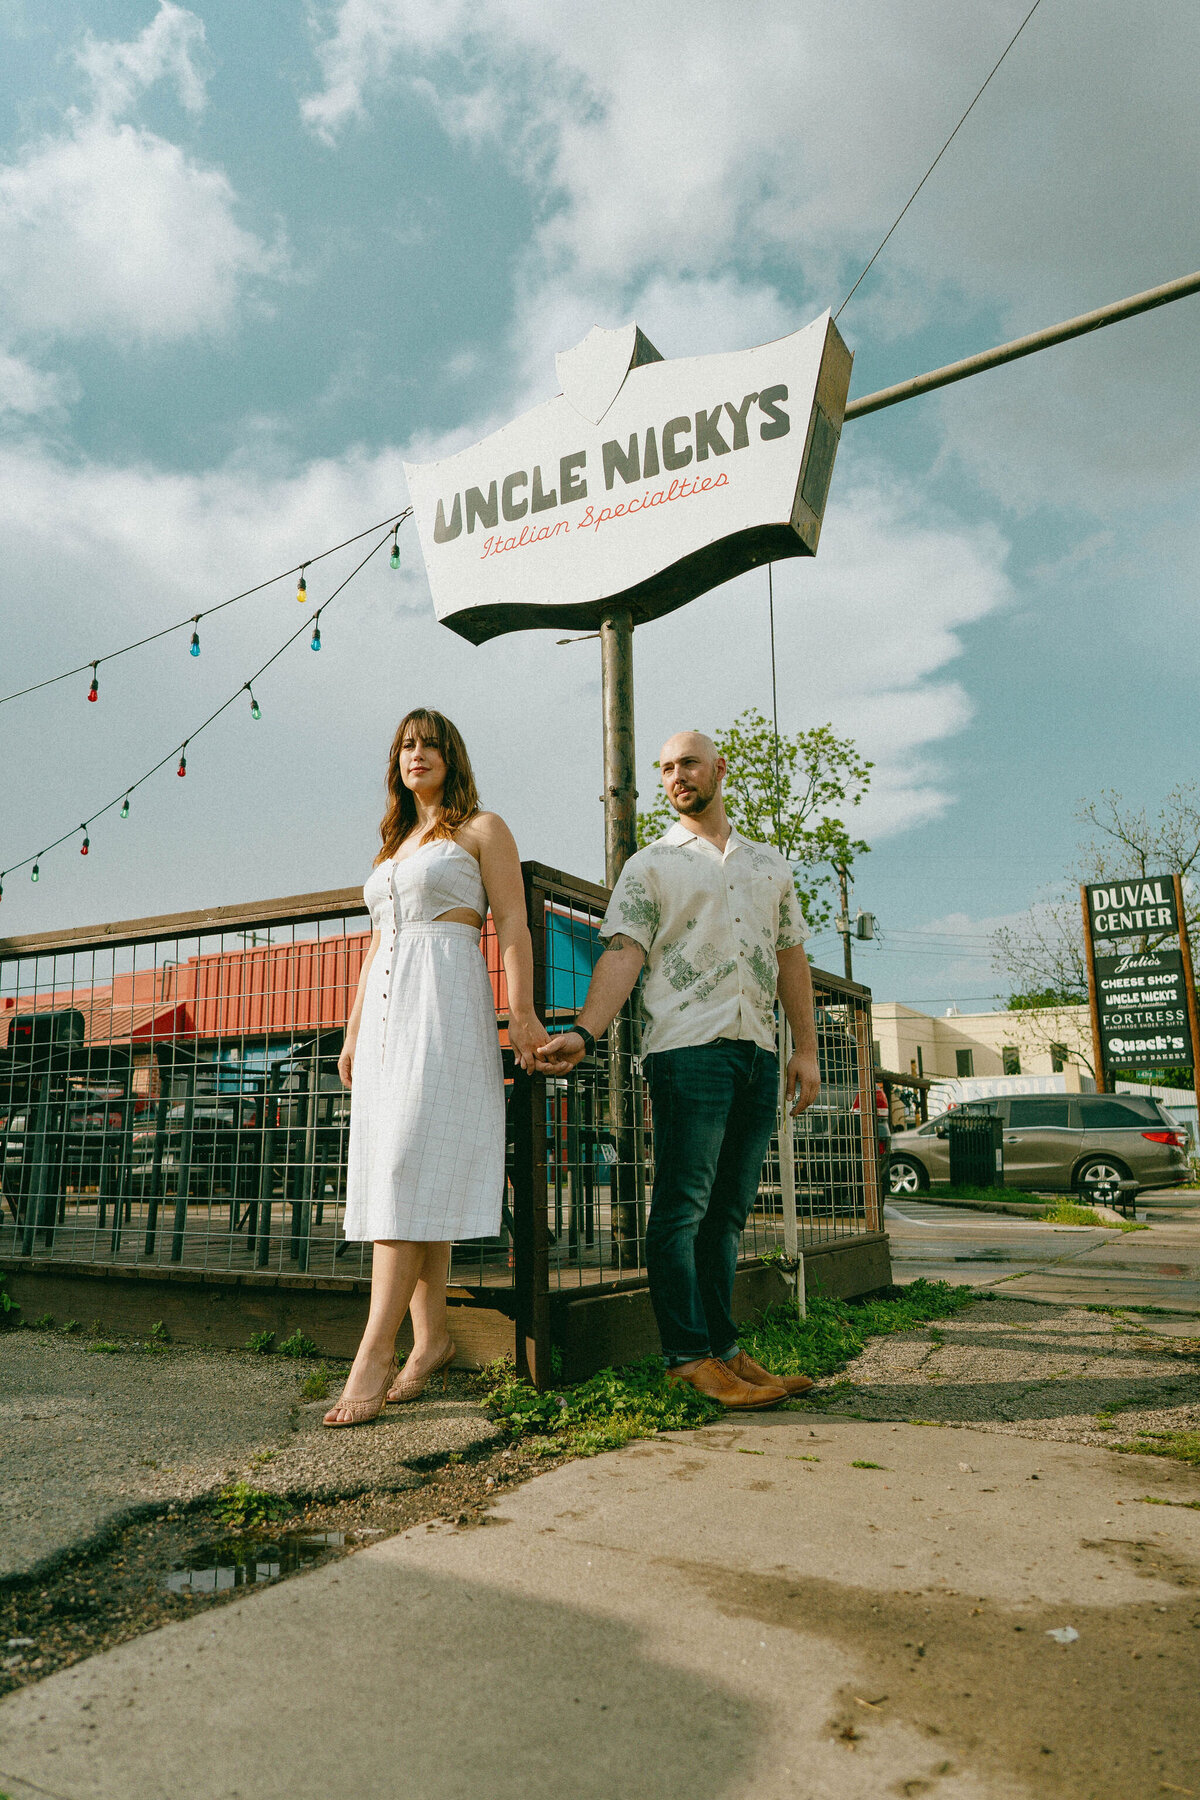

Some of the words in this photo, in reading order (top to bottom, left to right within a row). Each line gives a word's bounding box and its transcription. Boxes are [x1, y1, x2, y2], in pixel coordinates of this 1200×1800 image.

[434, 450, 588, 544] UNCLE
[602, 384, 790, 491] NICKY'S
[480, 521, 570, 559] Italian
[577, 473, 729, 532] Specialties
[1092, 882, 1170, 911] DUVAL
[1094, 908, 1172, 932] CENTER
[1114, 953, 1162, 974] Julio's
[1101, 976, 1145, 989] CHEESE
[1147, 973, 1179, 986] SHOP
[1105, 992, 1140, 1005] UNCLE
[1103, 1009, 1185, 1025] FORTRESS
[1108, 1035, 1184, 1055] Quack's
